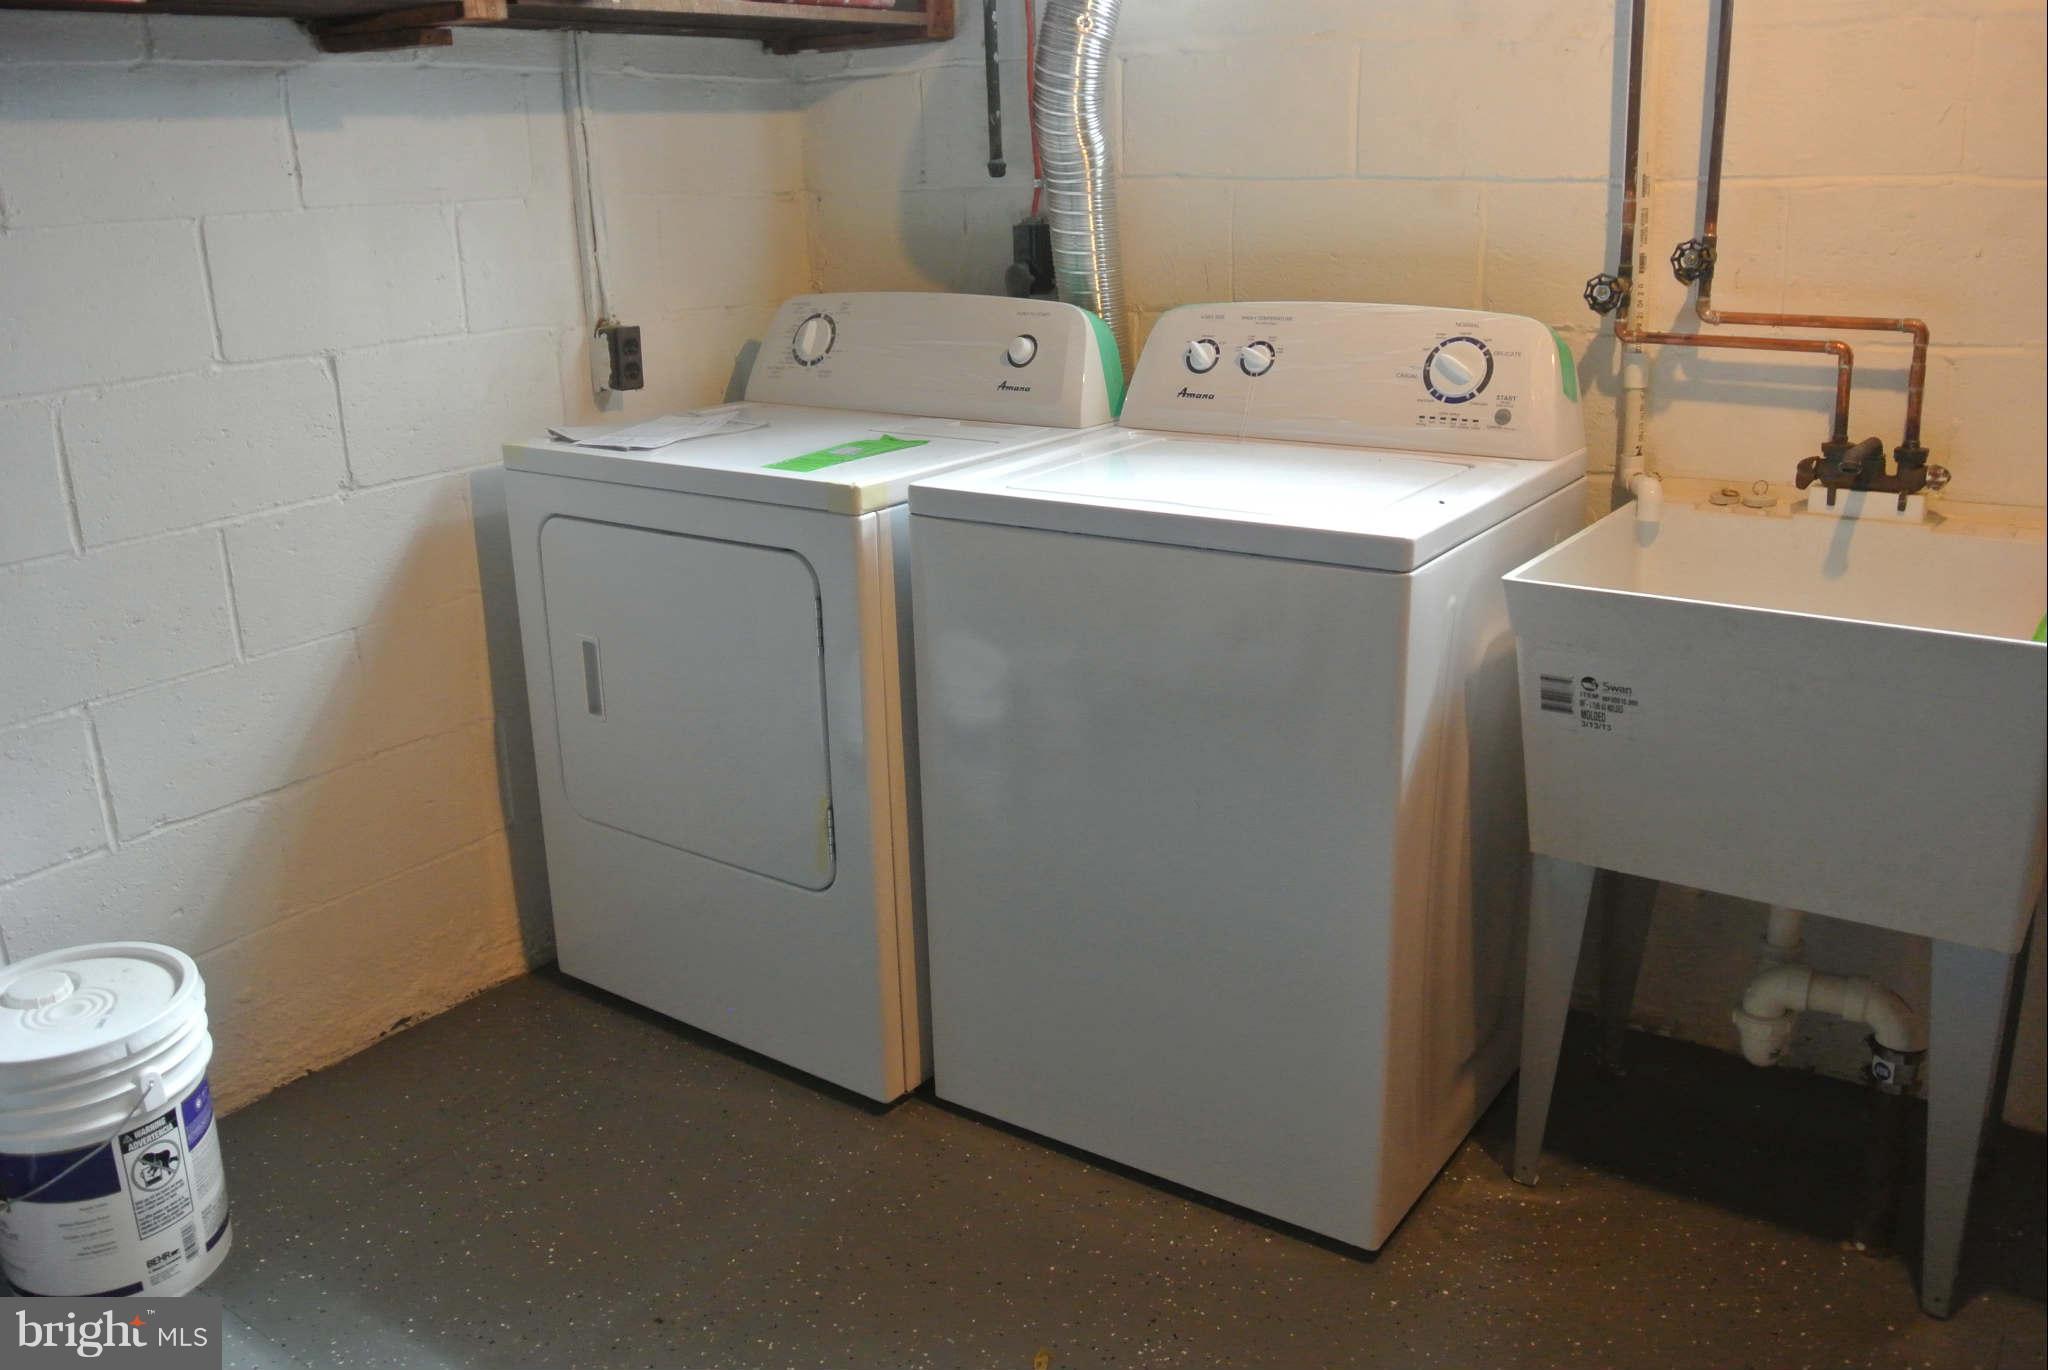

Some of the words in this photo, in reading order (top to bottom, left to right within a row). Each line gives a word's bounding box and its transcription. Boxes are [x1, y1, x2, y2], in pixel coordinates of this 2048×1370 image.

[997, 380, 1031, 392] Amana
[1177, 387, 1215, 400] Amana
[1602, 681, 1633, 696] Swan
[1580, 709, 1606, 722] MOLDED
[133, 1116, 167, 1139] WARNING
[146, 1251, 170, 1269] BEHR
